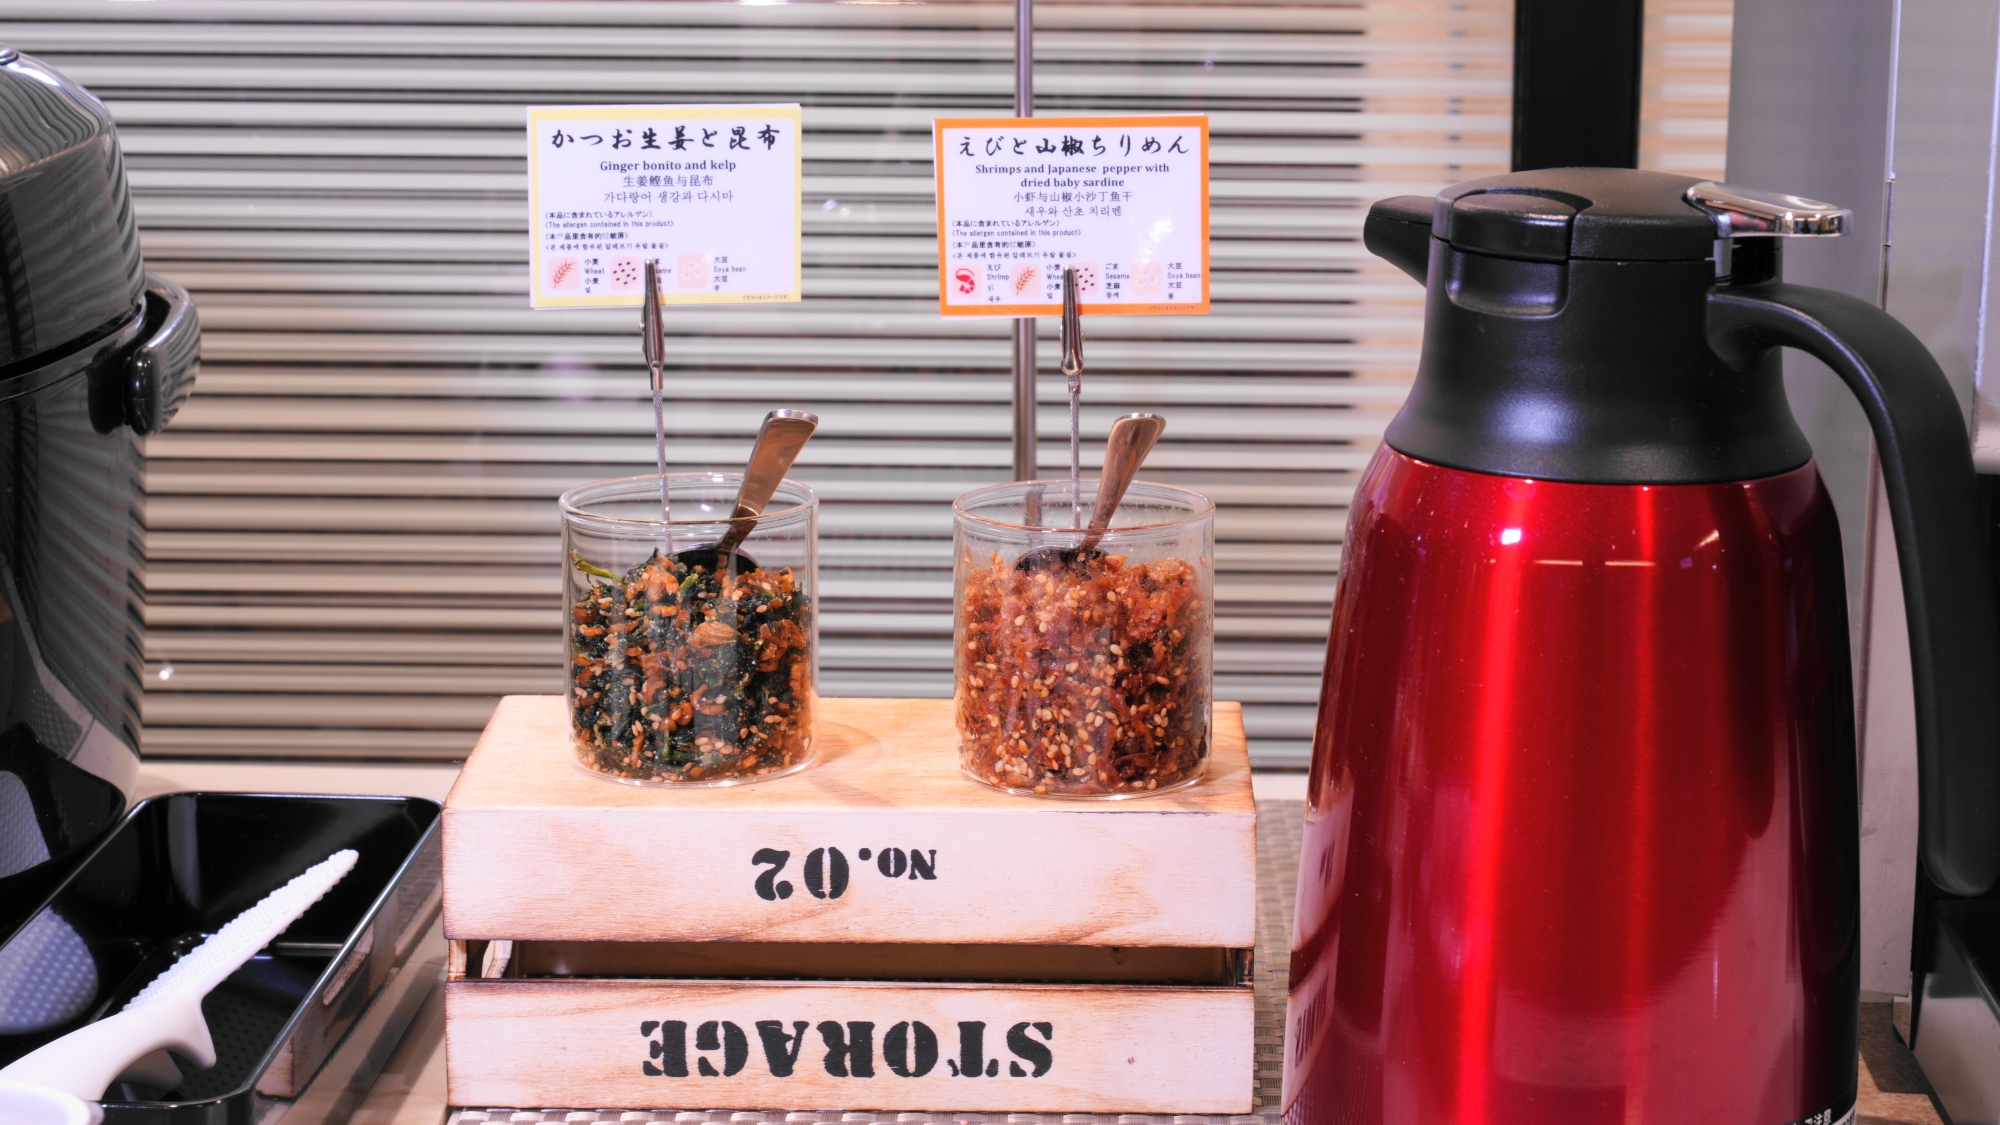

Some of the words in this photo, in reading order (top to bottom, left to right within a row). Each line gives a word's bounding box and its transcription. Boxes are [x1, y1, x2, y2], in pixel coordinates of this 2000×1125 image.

[551, 124, 780, 150] かつお生姜と昆布
[959, 134, 1189, 157] えびと山椒ちりめん
[600, 160, 639, 173] Ginger
[643, 160, 681, 170] bonito
[685, 160, 706, 170] and
[710, 160, 736, 172] kelp
[975, 164, 1021, 175] Shrimps
[1024, 164, 1044, 173] and
[1047, 164, 1096, 175] Japanese
[1103, 165, 1142, 175] pepper
[1145, 164, 1169, 172] with
[1021, 178, 1050, 187] dried
[1054, 178, 1080, 189] baby
[1083, 178, 1124, 186] sardine
[604, 191, 651, 203] 가다랑어
[658, 191, 692, 203] 생강과
[697, 190, 733, 203] 다시마
[1013, 191, 1133, 202] 小虾与山椒小沙丁鱼干
[1025, 206, 1058, 217] 새우와
[1063, 206, 1084, 216] 산초
[1089, 205, 1122, 216] 치리멘
[641, 1020, 1053, 1078] STORAGE
